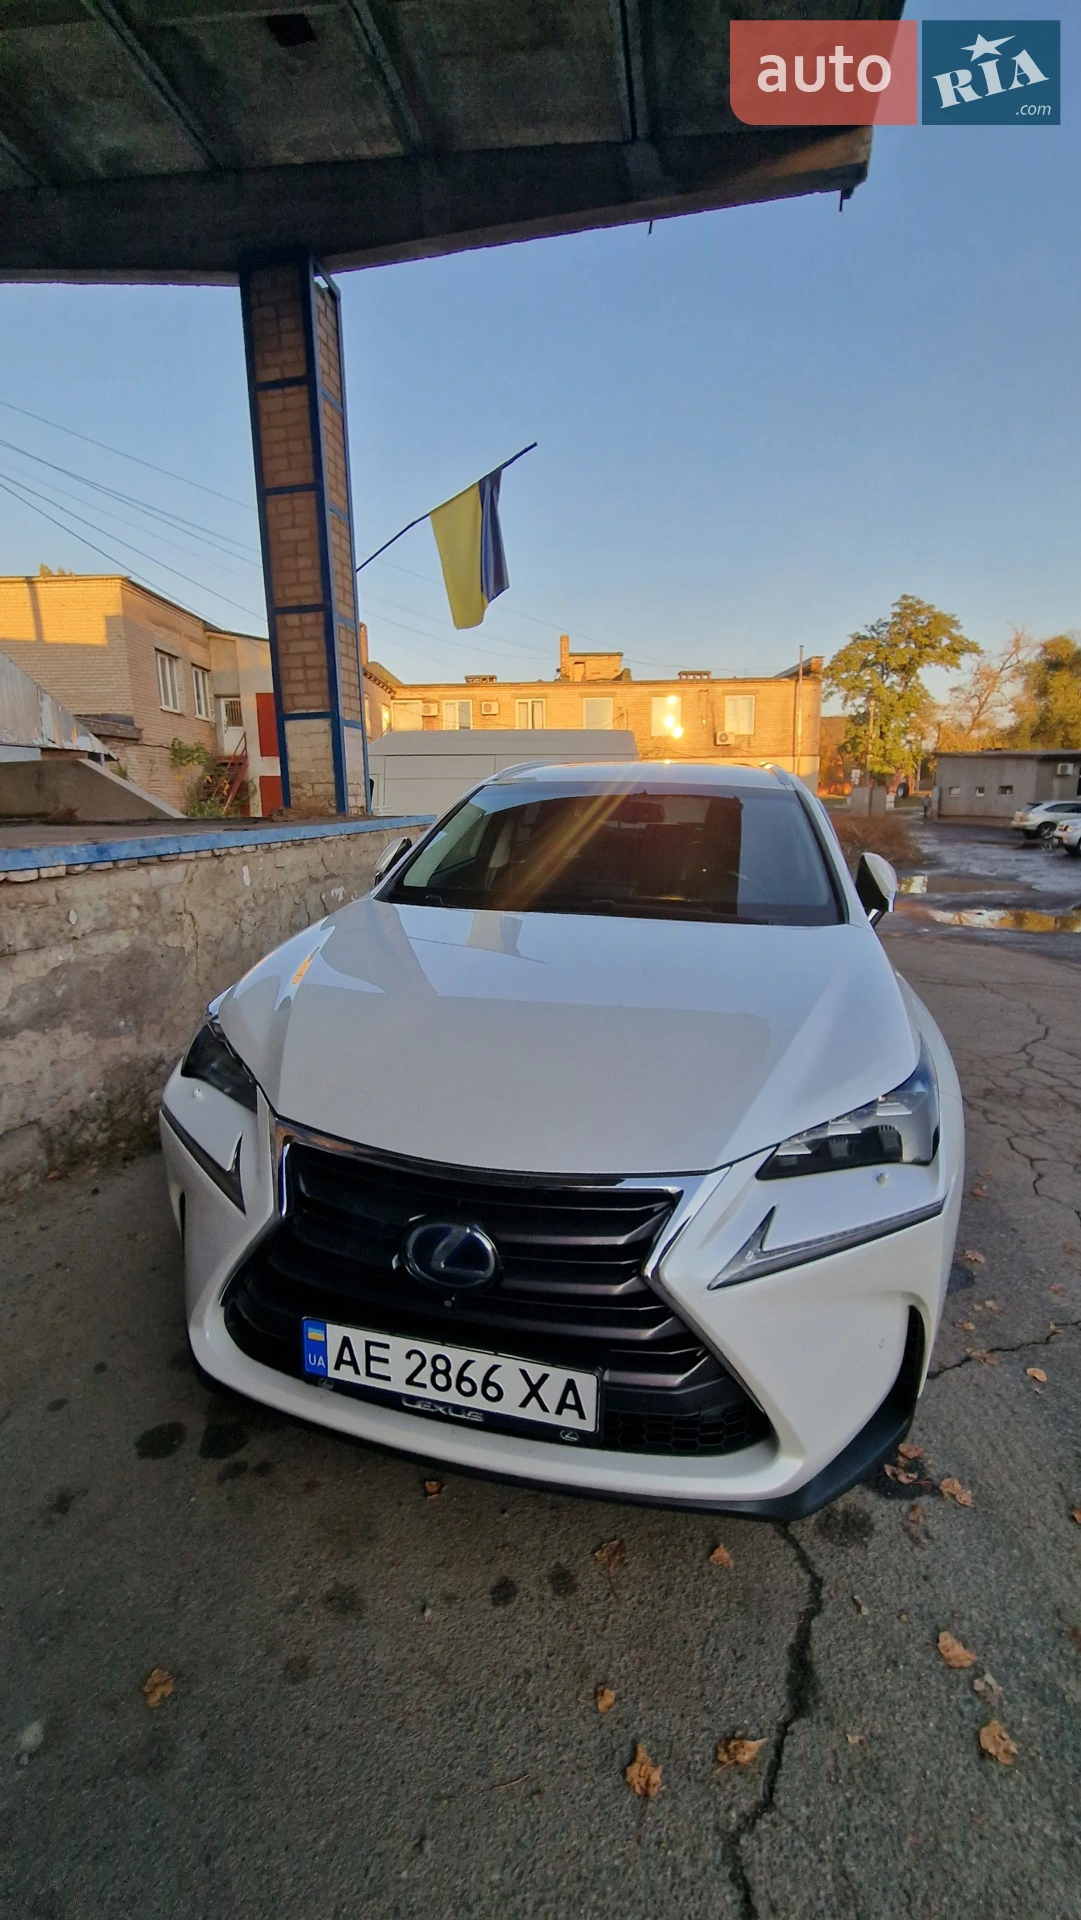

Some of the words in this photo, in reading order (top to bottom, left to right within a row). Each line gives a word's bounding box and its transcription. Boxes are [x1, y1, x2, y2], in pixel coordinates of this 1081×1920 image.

[308, 1354, 326, 1368] UA
[333, 1335, 391, 1382] AE
[405, 1349, 504, 1403] 2866
[518, 1368, 587, 1421] XA
[402, 1397, 484, 1422] LEXUS
